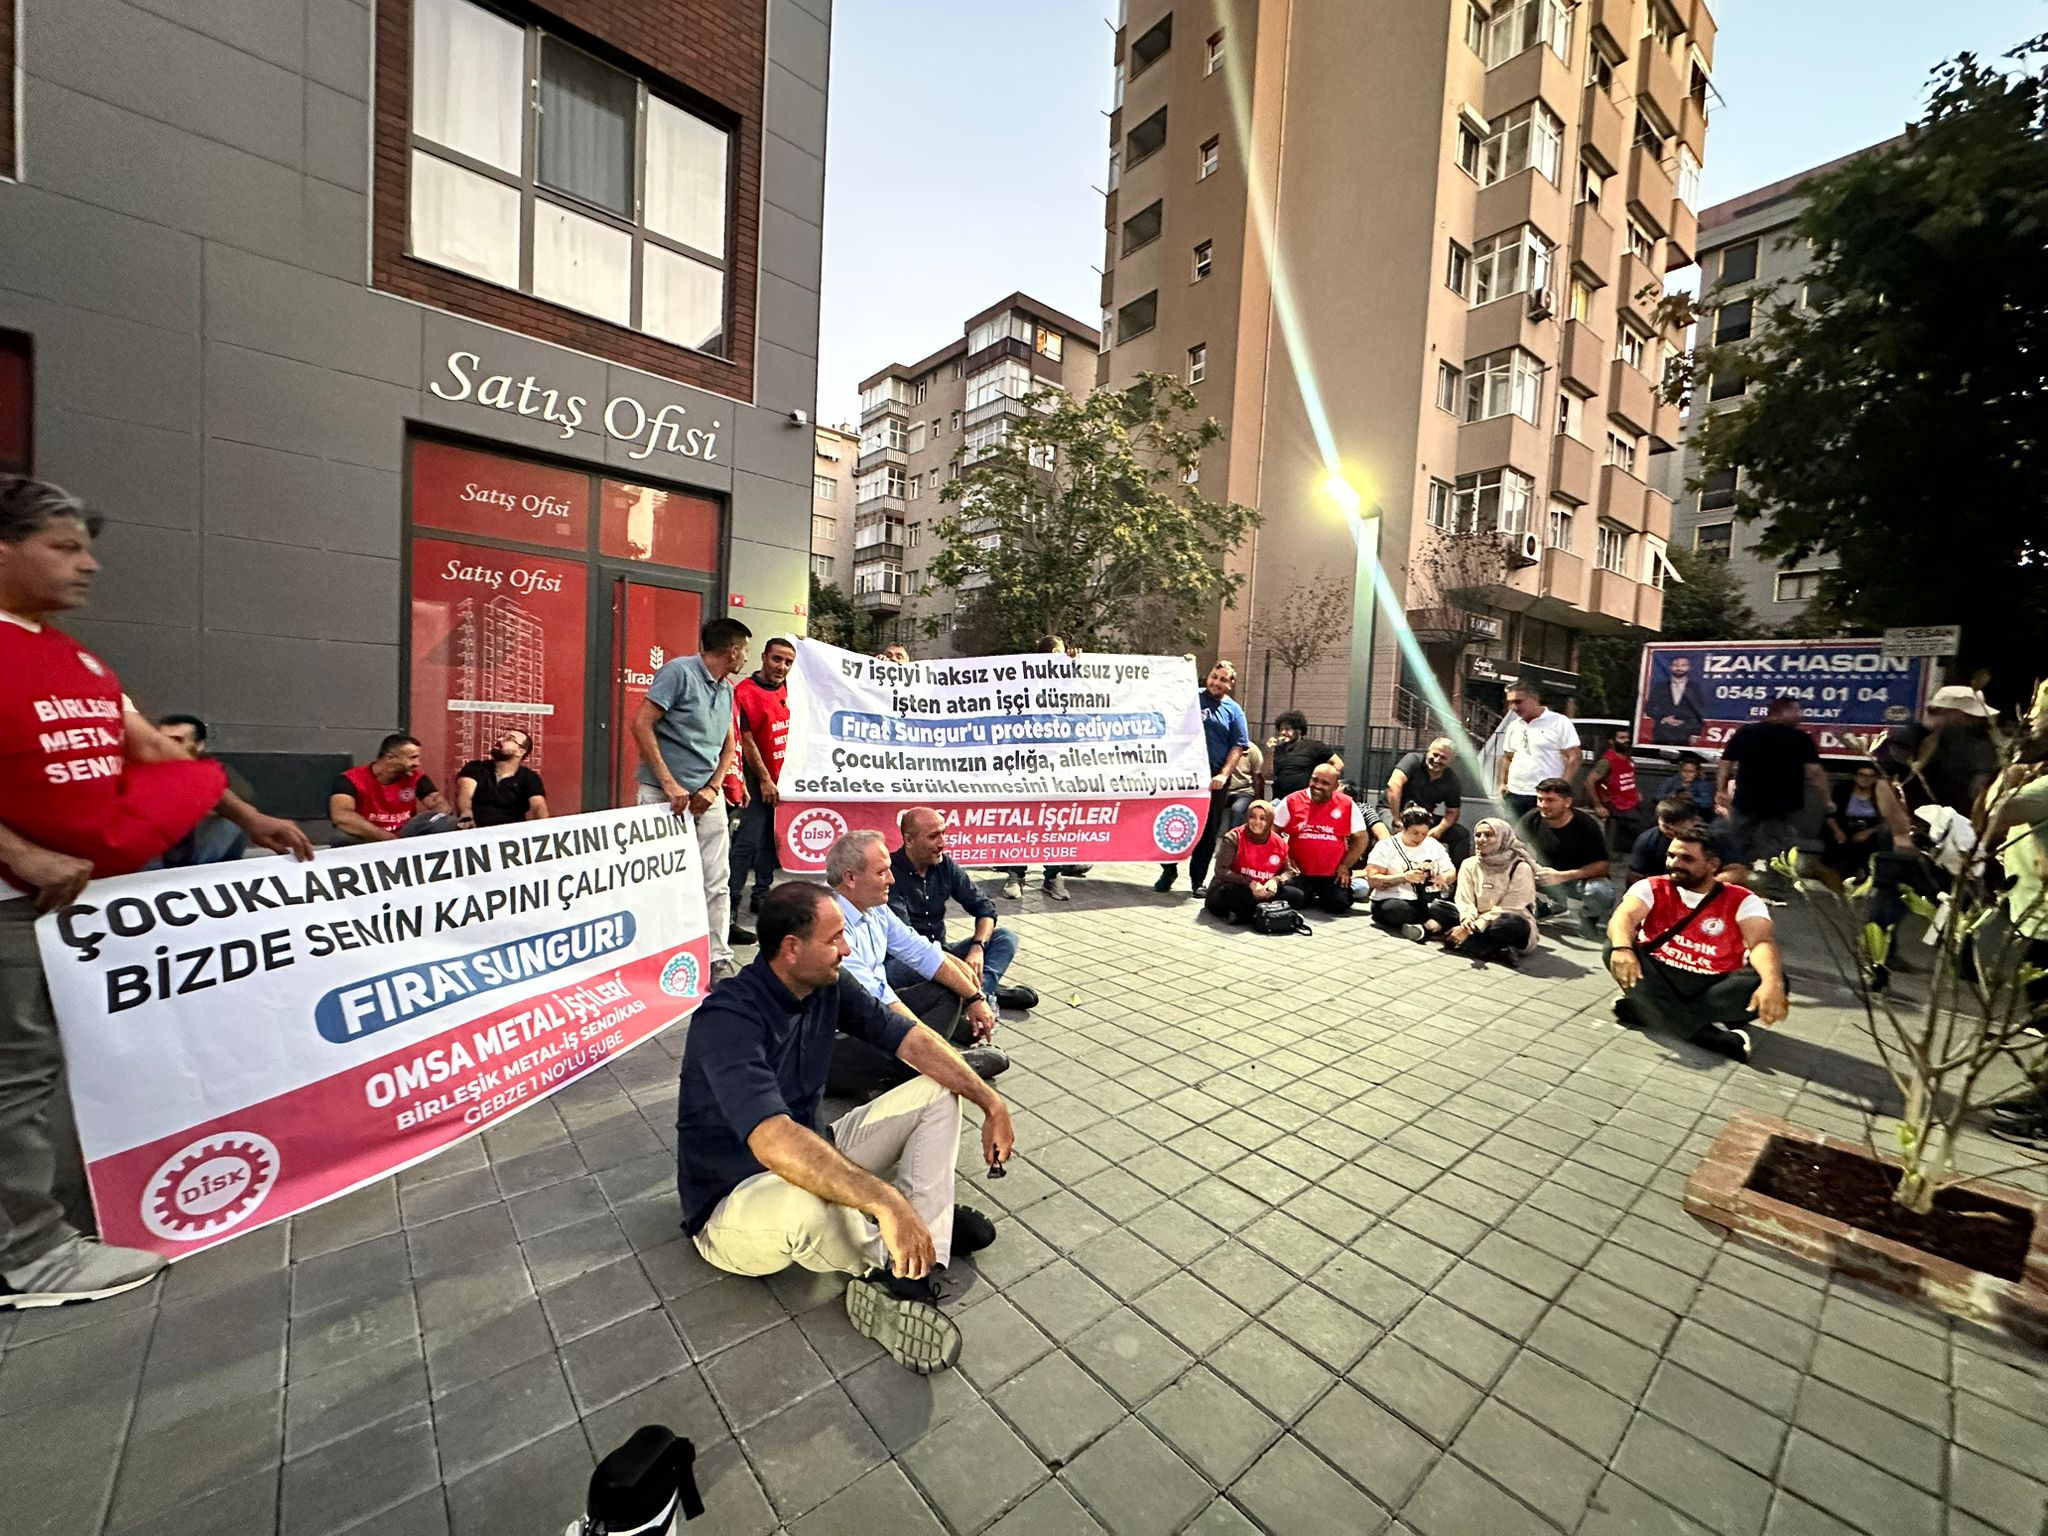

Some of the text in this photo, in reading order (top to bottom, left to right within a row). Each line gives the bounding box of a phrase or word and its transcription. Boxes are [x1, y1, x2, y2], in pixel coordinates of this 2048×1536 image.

[430, 351, 720, 461] Satış Ofisi
[460, 483, 571, 518] Satış Ofisi
[441, 560, 563, 594] Satış Ofisi
[841, 658, 1150, 687] 57 işçiyi haksız ve hukuksuz yere
[1781, 654, 1909, 673] HASON
[892, 687, 1110, 718] işten atan işçi düşmanı
[1715, 685, 1768, 700] 0545
[1774, 686, 1815, 701] 794
[1822, 687, 1850, 701] 01
[842, 715, 1157, 748] Fırat Sungur'u protesto ediyoruz.
[832, 743, 1168, 776] Çocuklarımızın açlığa, ailelerimizin
[794, 772, 1200, 796] sefalete sürüklenmesini kabul etmiyoruz!
[804, 827, 832, 839] DİSK
[964, 807, 1035, 828] METAL
[1038, 802, 1121, 831] İŞÇİLERİ
[975, 830, 1039, 847] METAL-İŞ
[1041, 829, 1110, 843] SENDİKASI
[999, 848, 1041, 860] NO'LU
[1043, 847, 1078, 861] ŞUBE
[56, 814, 688, 962] ÇOCUKLARIMIZIN RIZKINI ÇALDIN
[106, 848, 686, 1014] BİZDE SENİN KAPINI ÇALIYORUZ
[338, 915, 624, 1034] FIRAT SUNGUR!
[365, 970, 633, 1108] OMSA METAL İŞÇİLERİ
[395, 999, 647, 1131] BİRLEŞİK METAL-İŞ SENDİKASI
[463, 1029, 625, 1125] GEBZE 1 NO'LU ŞUBE
[181, 1167, 246, 1205] DİSK
